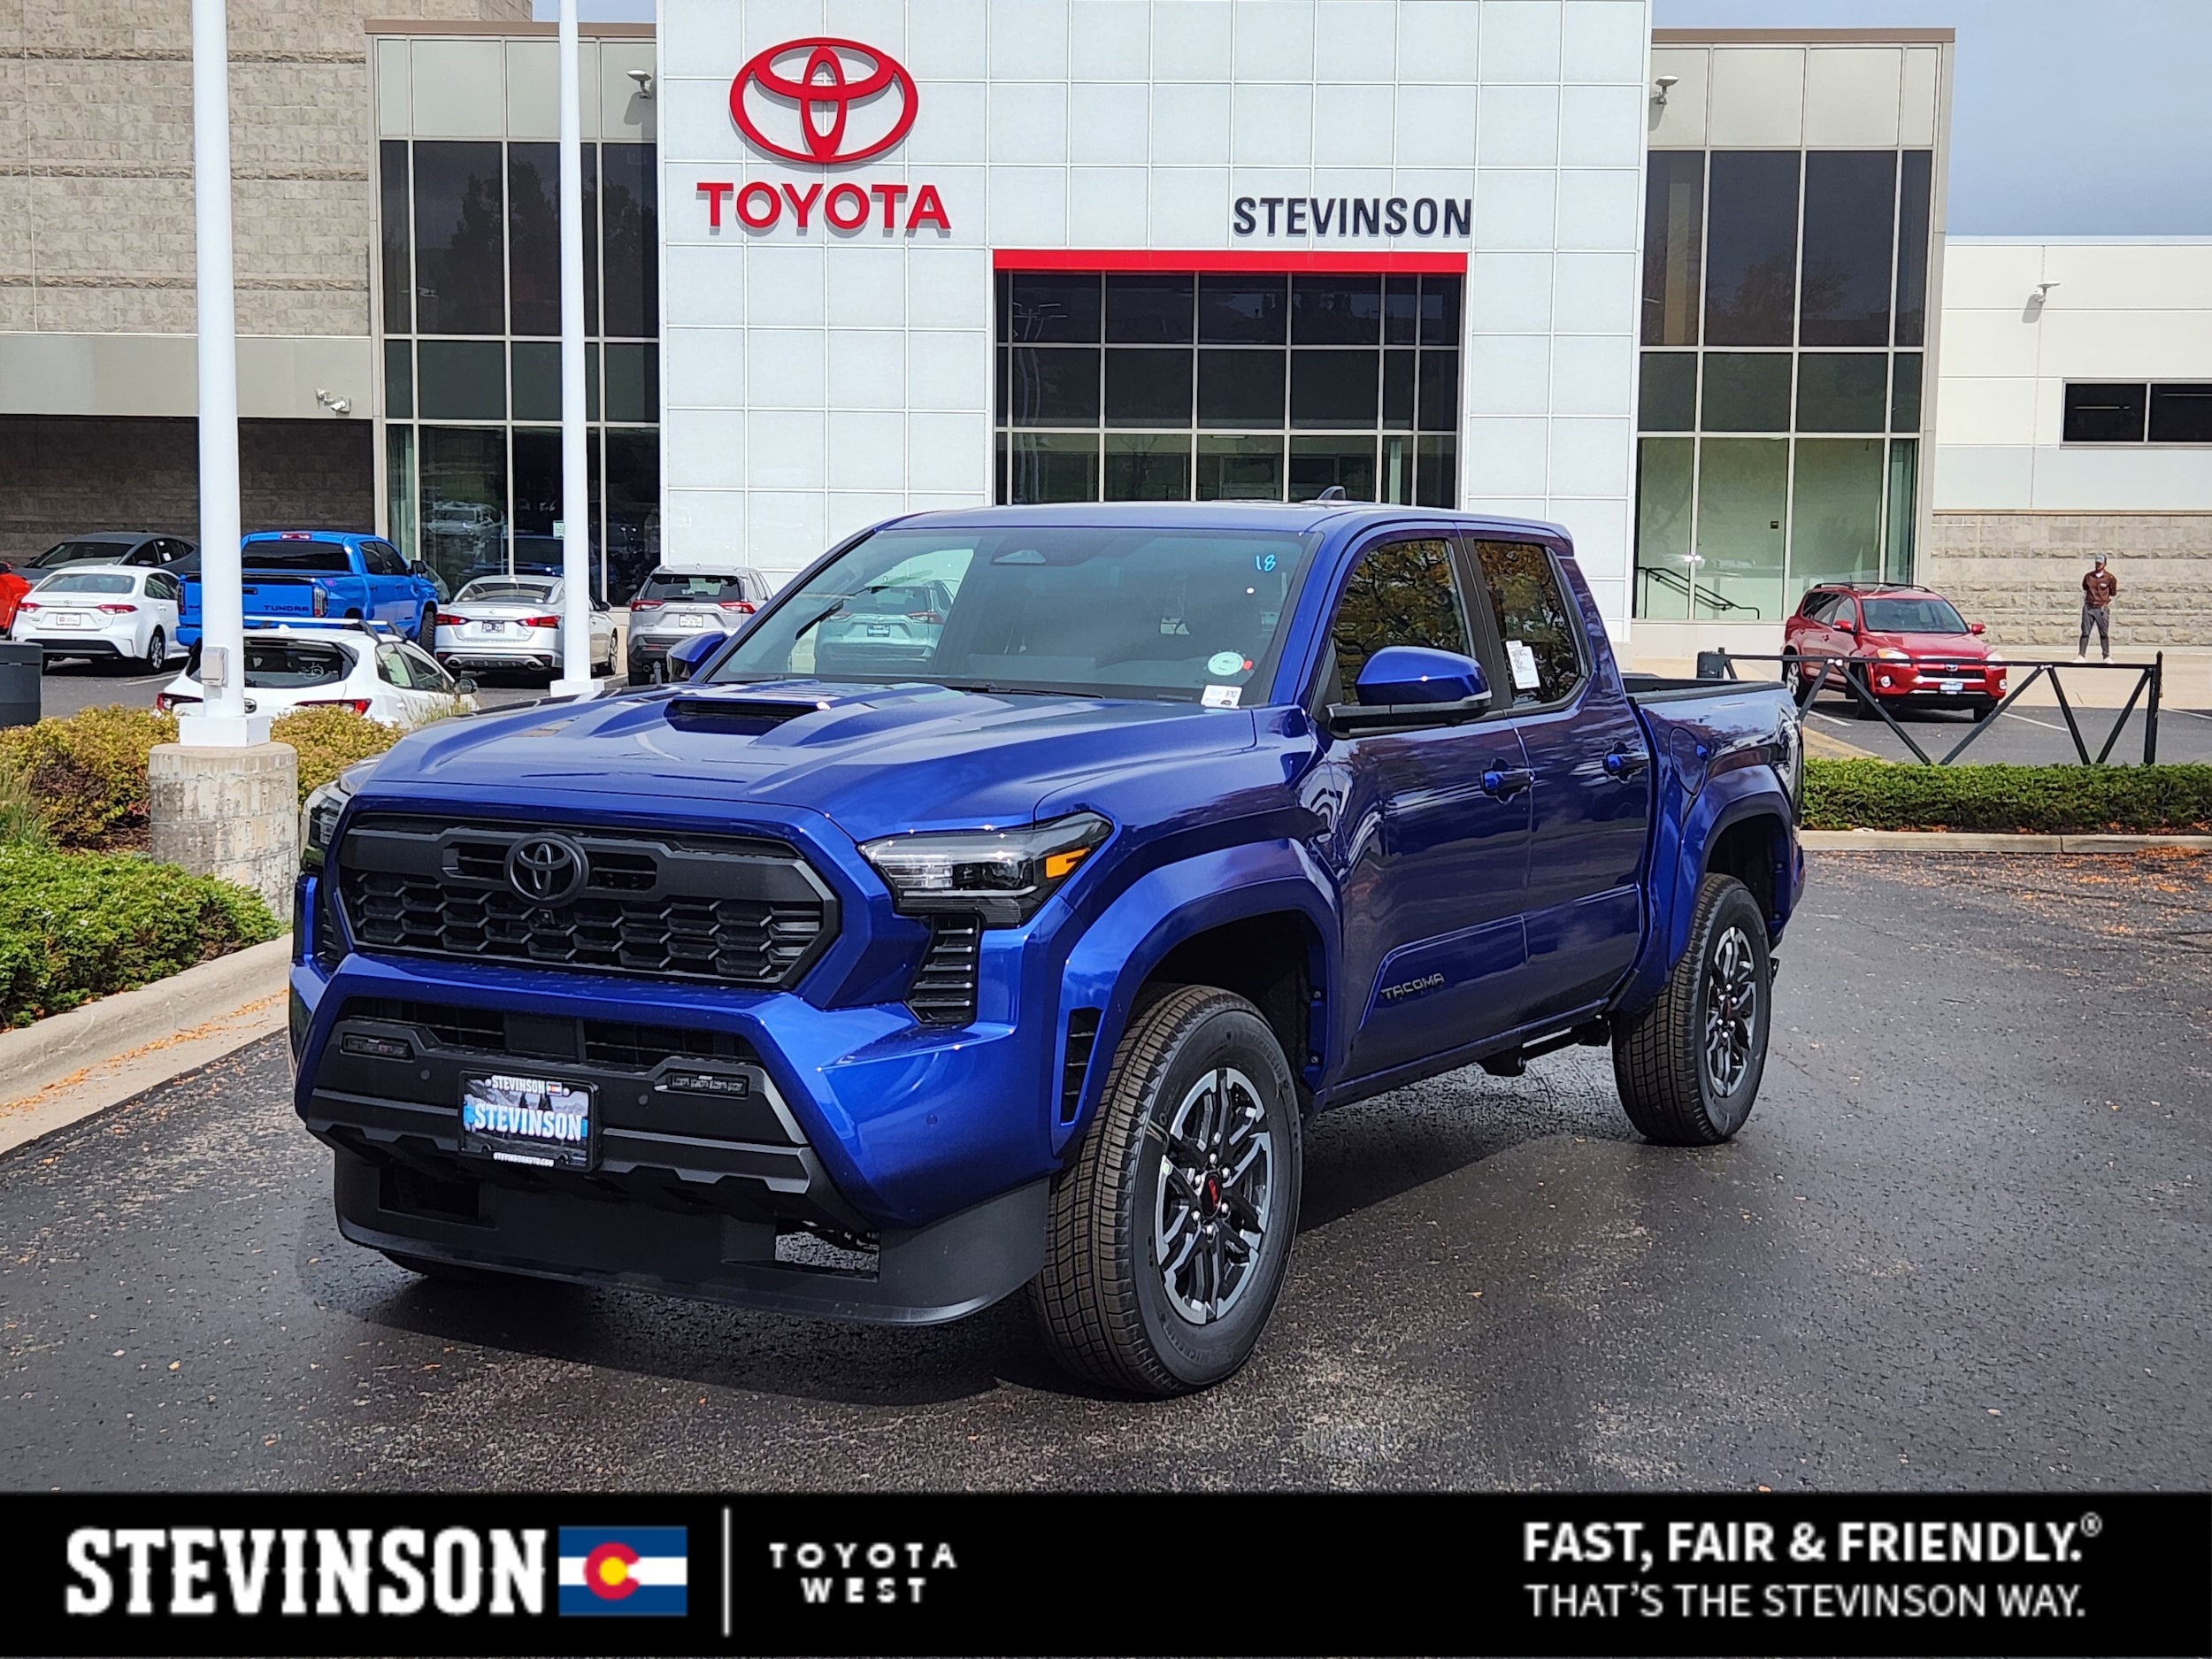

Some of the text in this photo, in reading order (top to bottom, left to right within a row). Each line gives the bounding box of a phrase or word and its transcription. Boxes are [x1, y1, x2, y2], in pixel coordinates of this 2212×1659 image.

[697, 182, 951, 230] TOYOTA
[1233, 197, 1471, 236] STEVINSON
[1256, 554, 1277, 572] 18
[1379, 972, 1445, 1000] TACOMA
[491, 1074, 545, 1094] STEVINSON
[473, 1102, 583, 1141] STEVINSON
